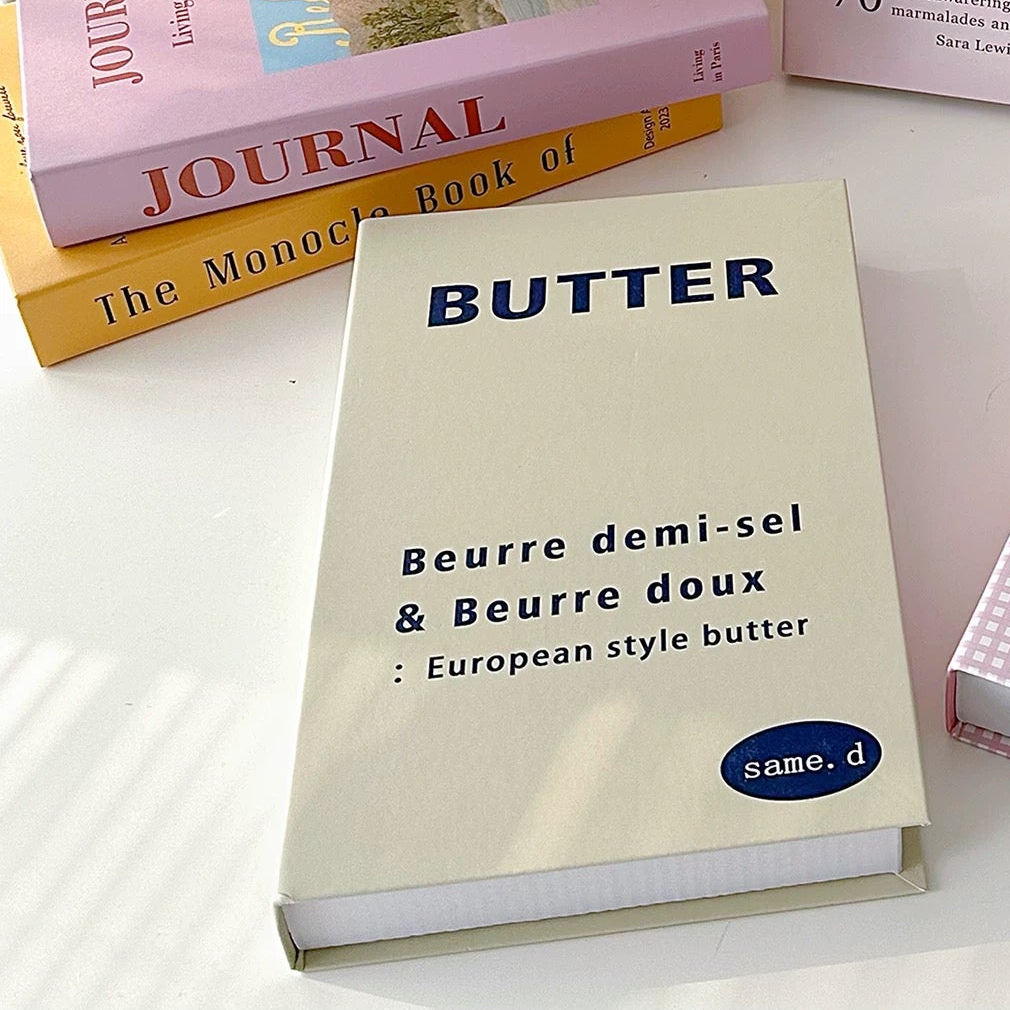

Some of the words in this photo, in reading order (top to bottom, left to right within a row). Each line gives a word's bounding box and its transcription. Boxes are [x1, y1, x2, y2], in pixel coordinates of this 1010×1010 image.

[890, 5, 986, 29] marmalades
[711, 41, 722, 69] Paris
[935, 33, 970, 51] Sara
[693, 49, 706, 84] Living
[713, 69, 723, 83] in
[643, 115, 656, 150] Design
[658, 106, 671, 131] 2023
[141, 95, 507, 217] JOURNAL
[94, 279, 179, 326] The
[415, 159, 517, 214] Book
[540, 133, 576, 172] of
[426, 256, 780, 329] BUTTER
[402, 536, 567, 577] Beurre
[592, 502, 803, 554] demi-sel
[394, 602, 426, 634] &
[453, 585, 621, 628] Beurre
[646, 568, 766, 605] doux
[427, 642, 594, 681] European
[606, 628, 690, 662] style
[702, 615, 809, 648] butter
